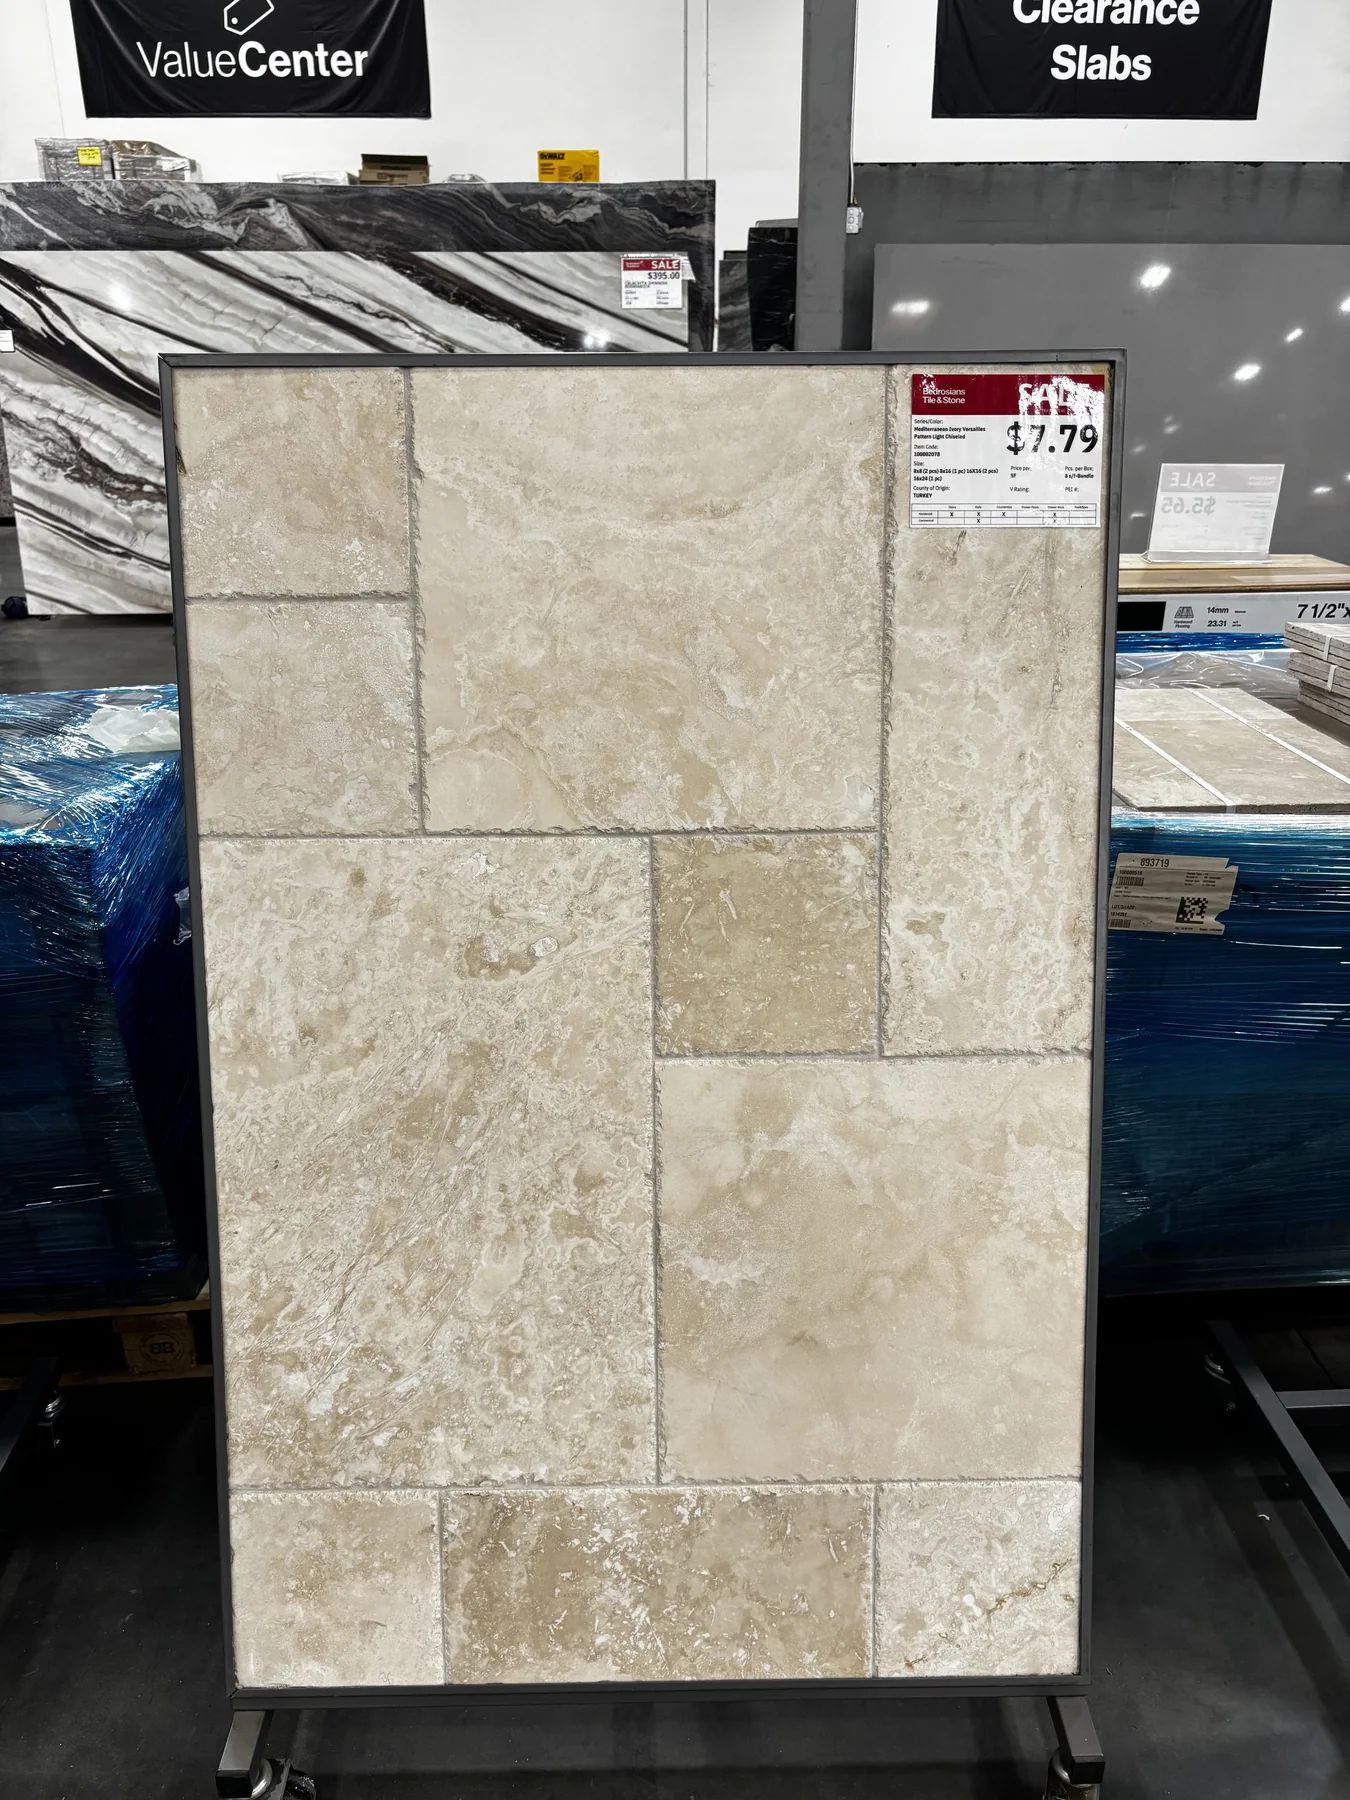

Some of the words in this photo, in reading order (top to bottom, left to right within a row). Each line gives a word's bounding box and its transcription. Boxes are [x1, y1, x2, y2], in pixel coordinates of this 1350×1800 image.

[1012, 0, 1200, 25] Clearance
[136, 41, 369, 78] ValueCenter
[1050, 44, 1152, 81] Slabs
[651, 260, 680, 269] SALE
[647, 272, 680, 280] $395.00
[922, 387, 966, 396] Bedrosians
[922, 396, 936, 404] Tile
[943, 396, 966, 404] Stone
[1006, 420, 1099, 456] $7.79
[1207, 606, 1229, 614] 14mm
[1140, 857, 1170, 868] 893719
